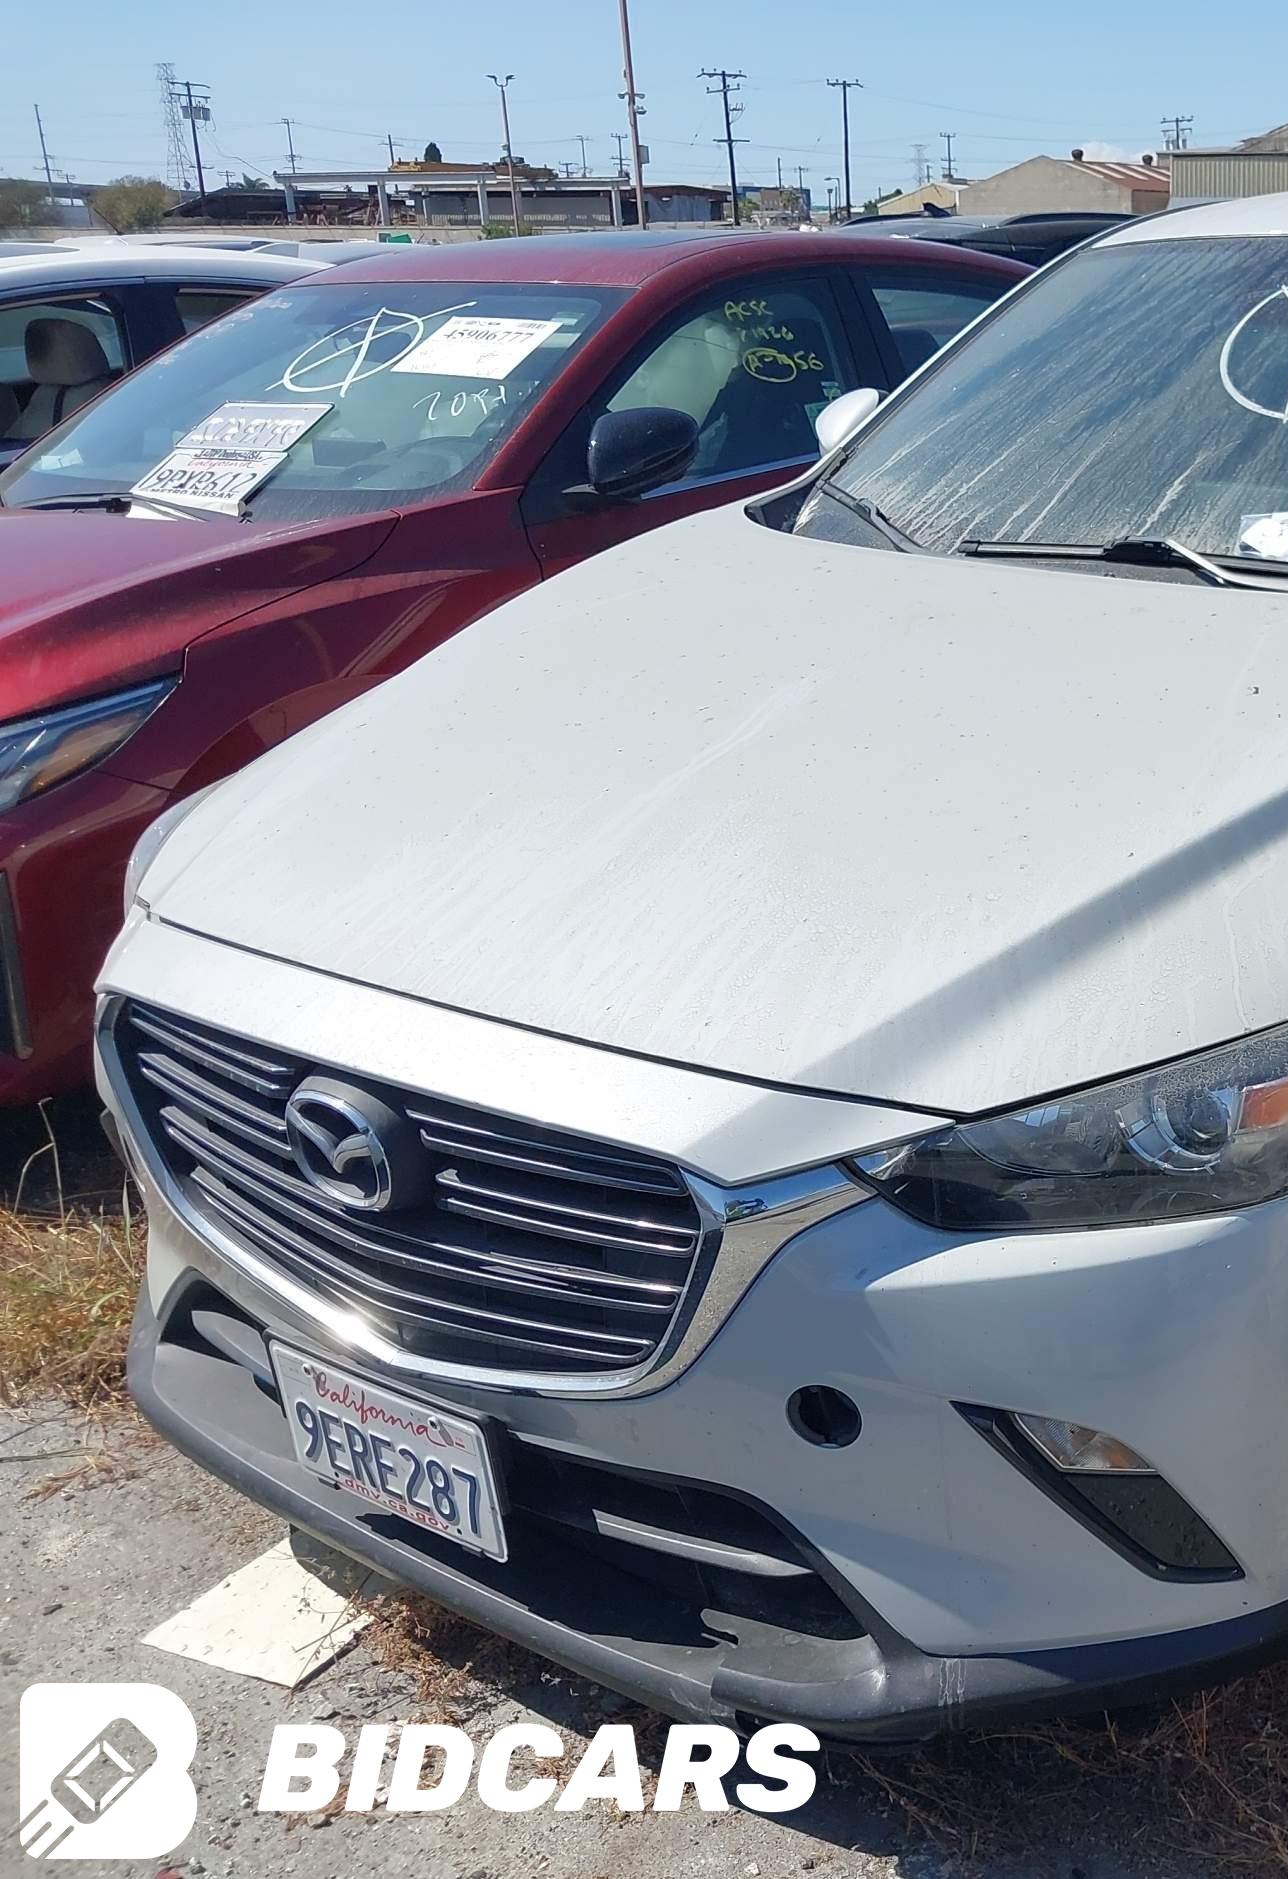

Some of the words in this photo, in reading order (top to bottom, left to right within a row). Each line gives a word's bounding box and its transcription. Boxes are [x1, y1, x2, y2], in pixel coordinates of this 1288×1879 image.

[443, 328, 536, 344] 45906777
[190, 489, 235, 499] NISSAN
[313, 1371, 448, 1448] California
[295, 1400, 479, 1536] 9ERE287
